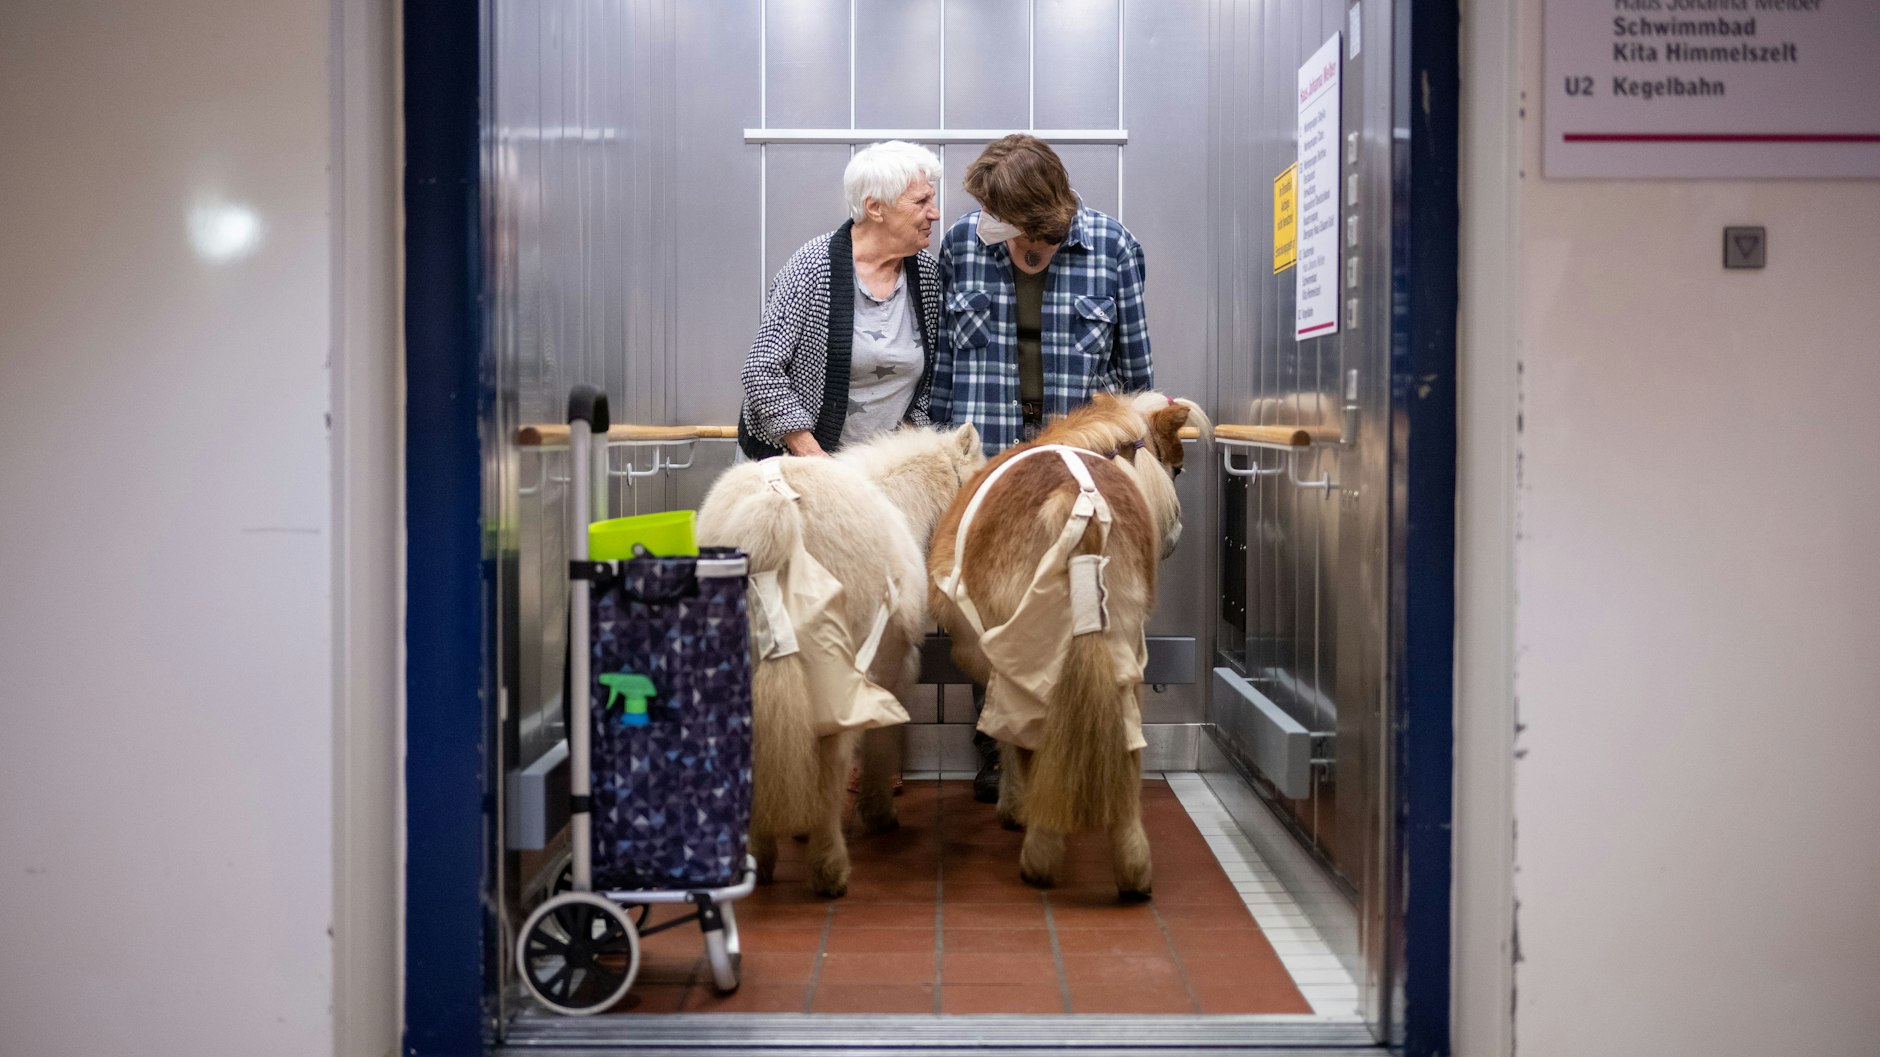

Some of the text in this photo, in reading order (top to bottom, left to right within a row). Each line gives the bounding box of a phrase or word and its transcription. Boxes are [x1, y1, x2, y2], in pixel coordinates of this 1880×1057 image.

[1613, 17, 1757, 36] Schwimmbad
[1613, 43, 1798, 62] Kita Himmelszelt
[1564, 77, 1726, 100] U2 Kegelbahn
